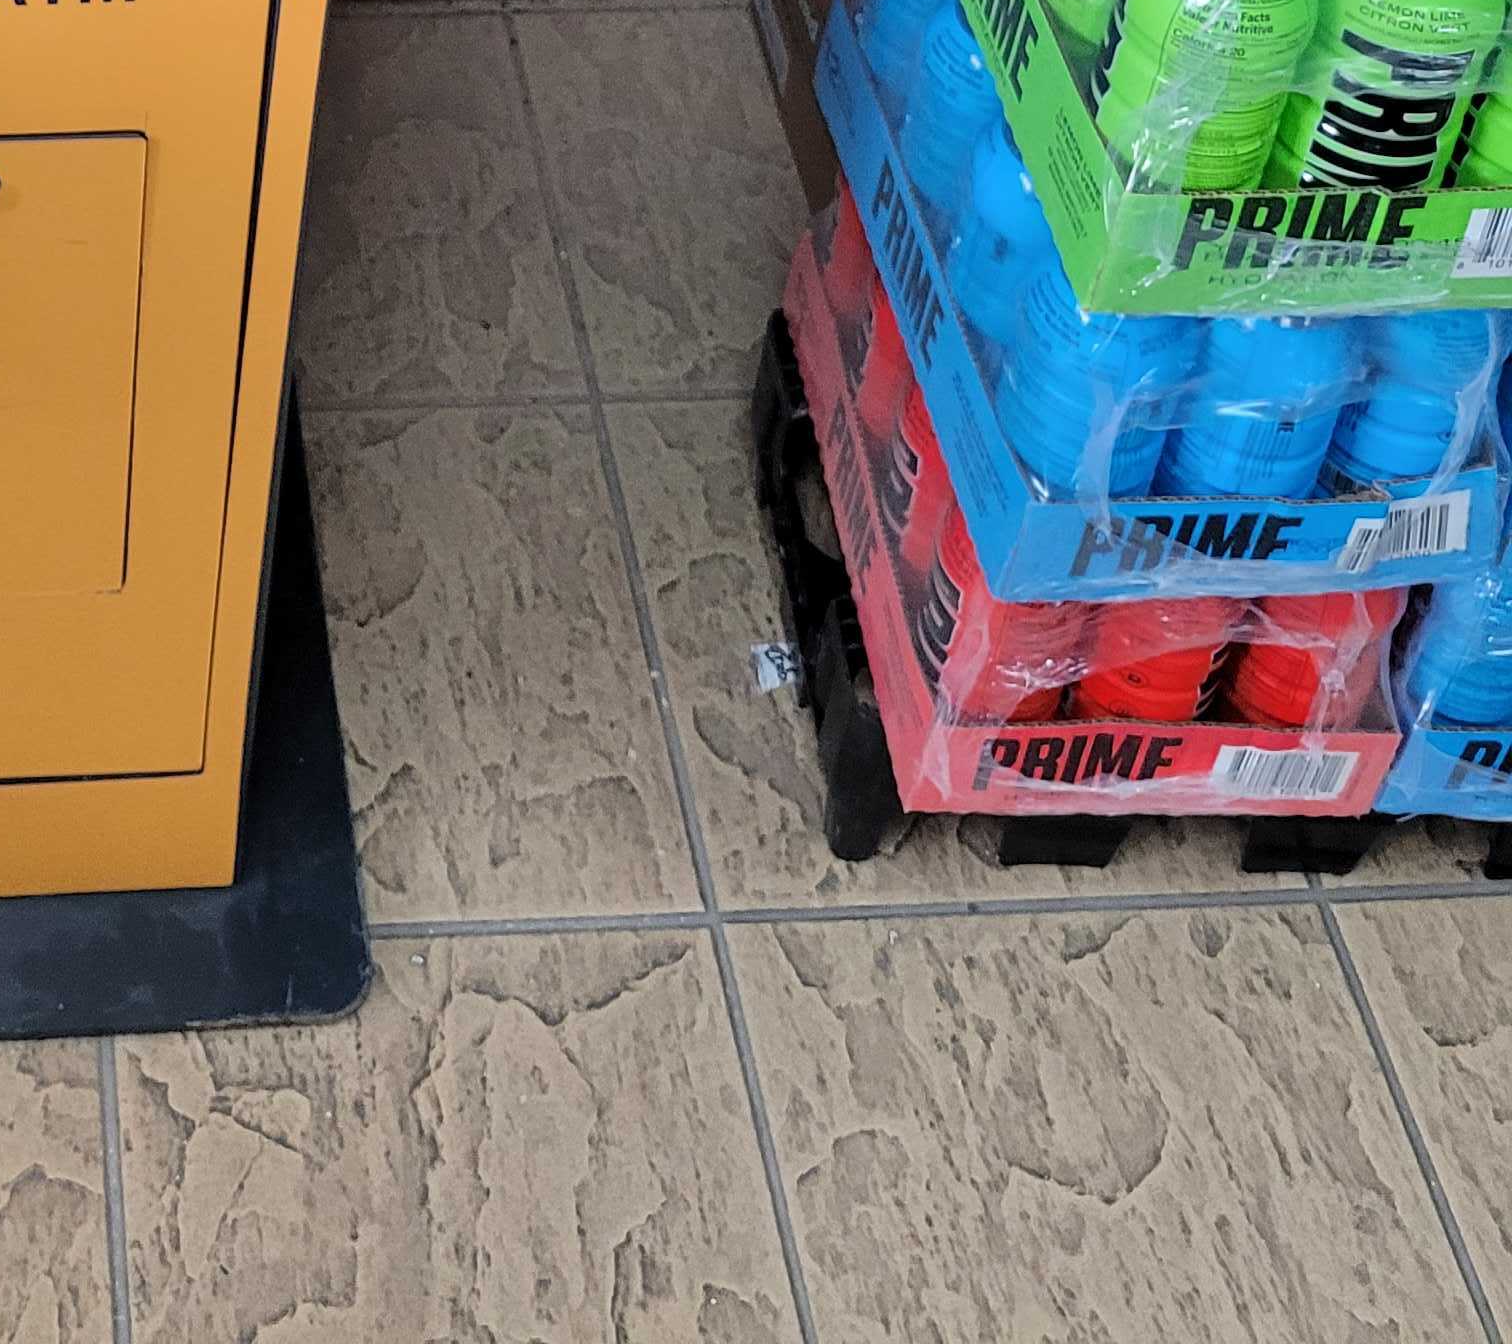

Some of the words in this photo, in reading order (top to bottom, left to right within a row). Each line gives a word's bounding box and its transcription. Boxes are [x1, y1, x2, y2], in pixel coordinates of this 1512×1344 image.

[1183, 10, 1219, 29] Valer
[1241, 12, 1271, 23] Facts
[1359, 5, 1424, 33] CITRON
[1298, 28, 1475, 191] PRIM
[1174, 192, 1428, 271] PRIME
[872, 157, 944, 372] PRIME
[1069, 512, 1303, 577] PRIME
[972, 733, 1183, 791] PRIME
